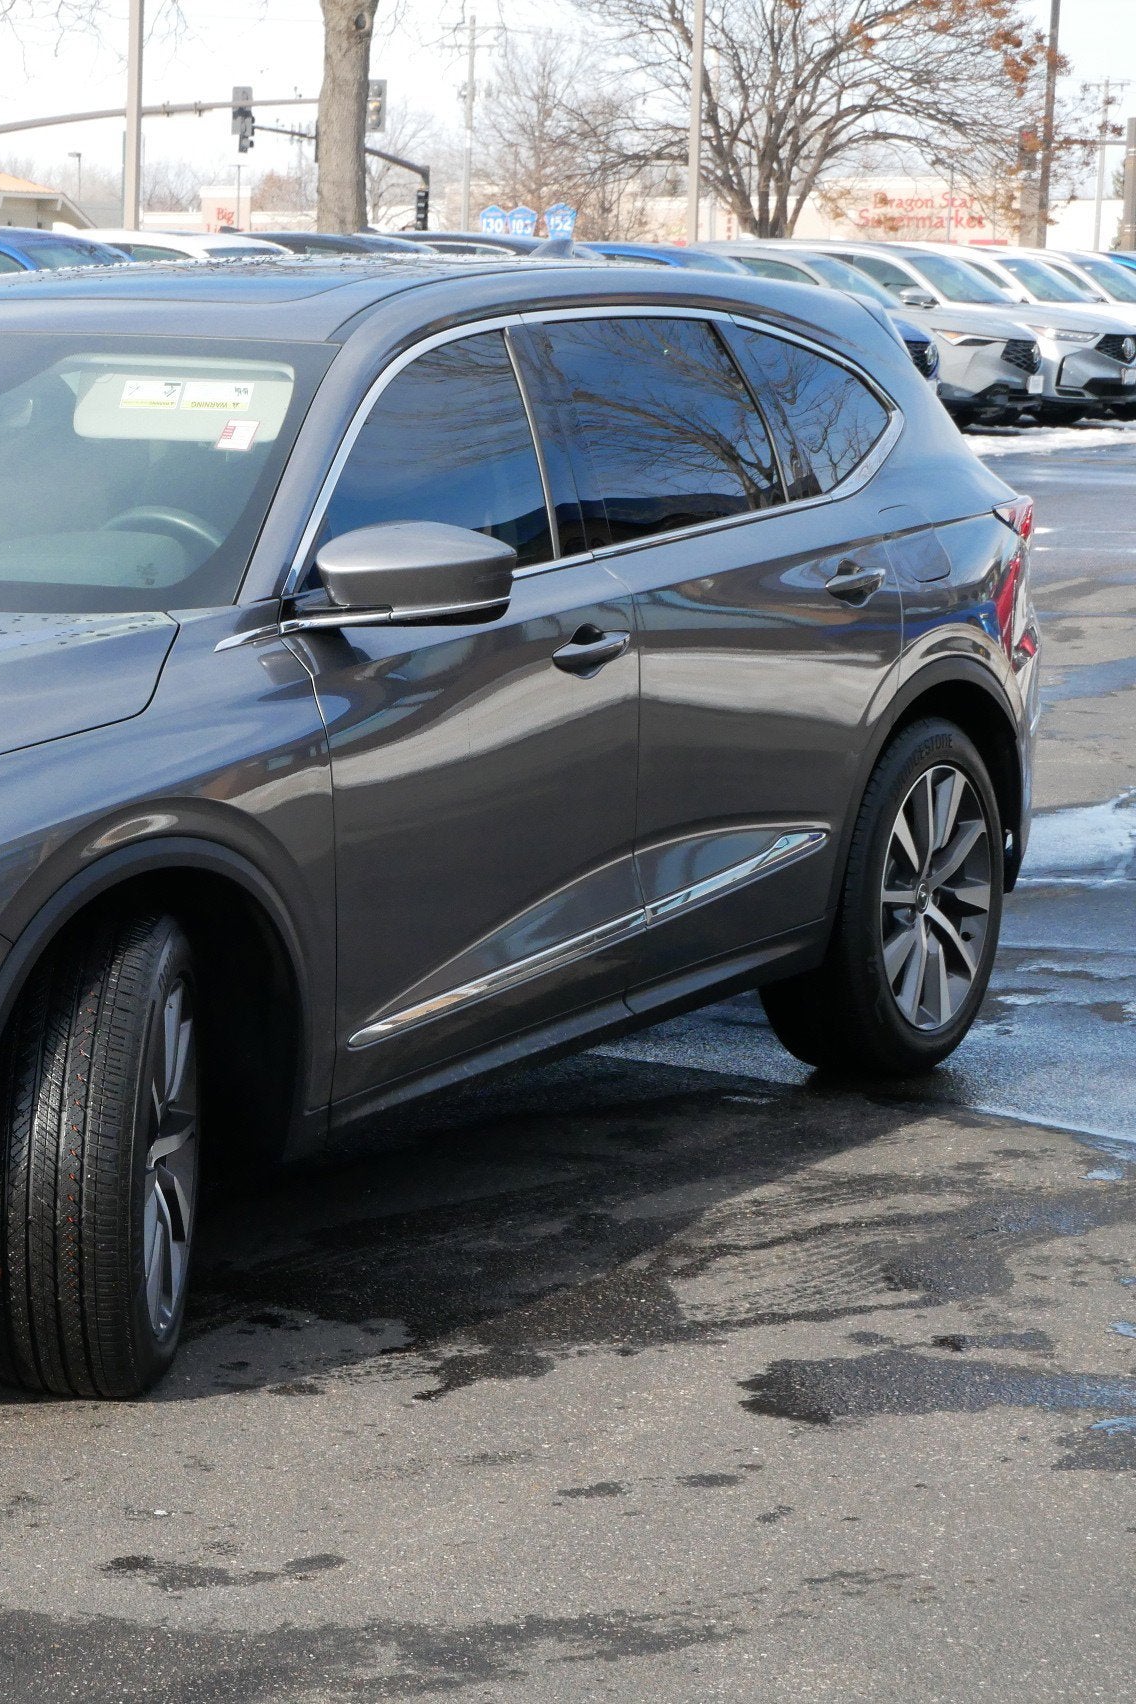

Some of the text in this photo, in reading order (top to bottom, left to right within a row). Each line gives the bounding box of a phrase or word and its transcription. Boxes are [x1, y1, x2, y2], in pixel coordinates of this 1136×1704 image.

[873, 192, 975, 211] Dragon Star
[216, 207, 235, 225] Big
[549, 215, 572, 231] 152
[482, 218, 504, 233] 130
